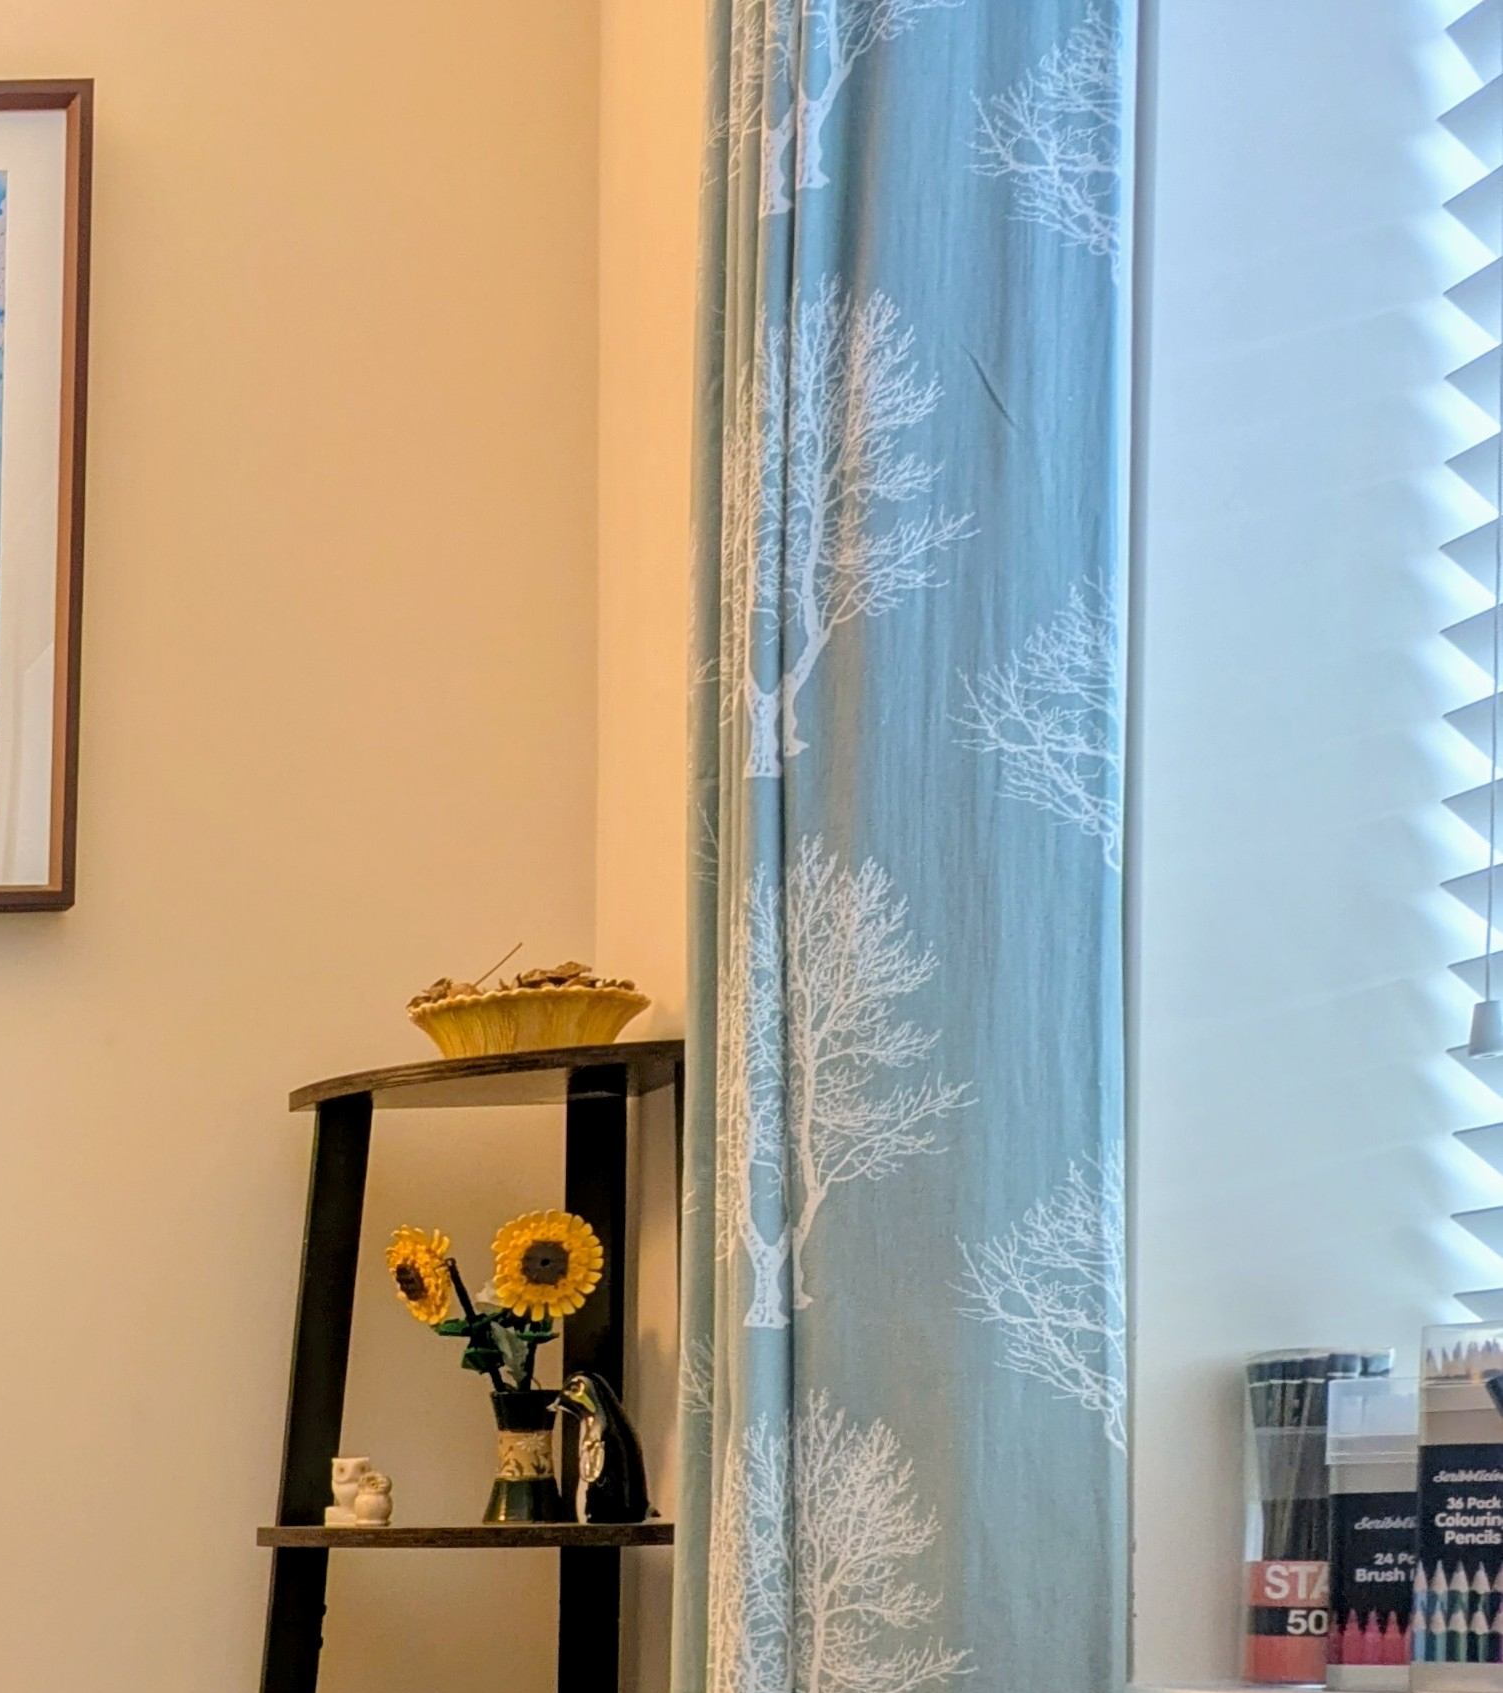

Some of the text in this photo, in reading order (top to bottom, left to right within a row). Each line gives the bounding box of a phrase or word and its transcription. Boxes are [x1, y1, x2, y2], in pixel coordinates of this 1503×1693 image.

[1446, 1496, 1502, 1510] 36 Pack
[1444, 1530, 1502, 1545] Pencils
[1374, 1553, 1394, 1565] 24
[1355, 1567, 1405, 1582] Brush
[1286, 1610, 1328, 1634] 50
